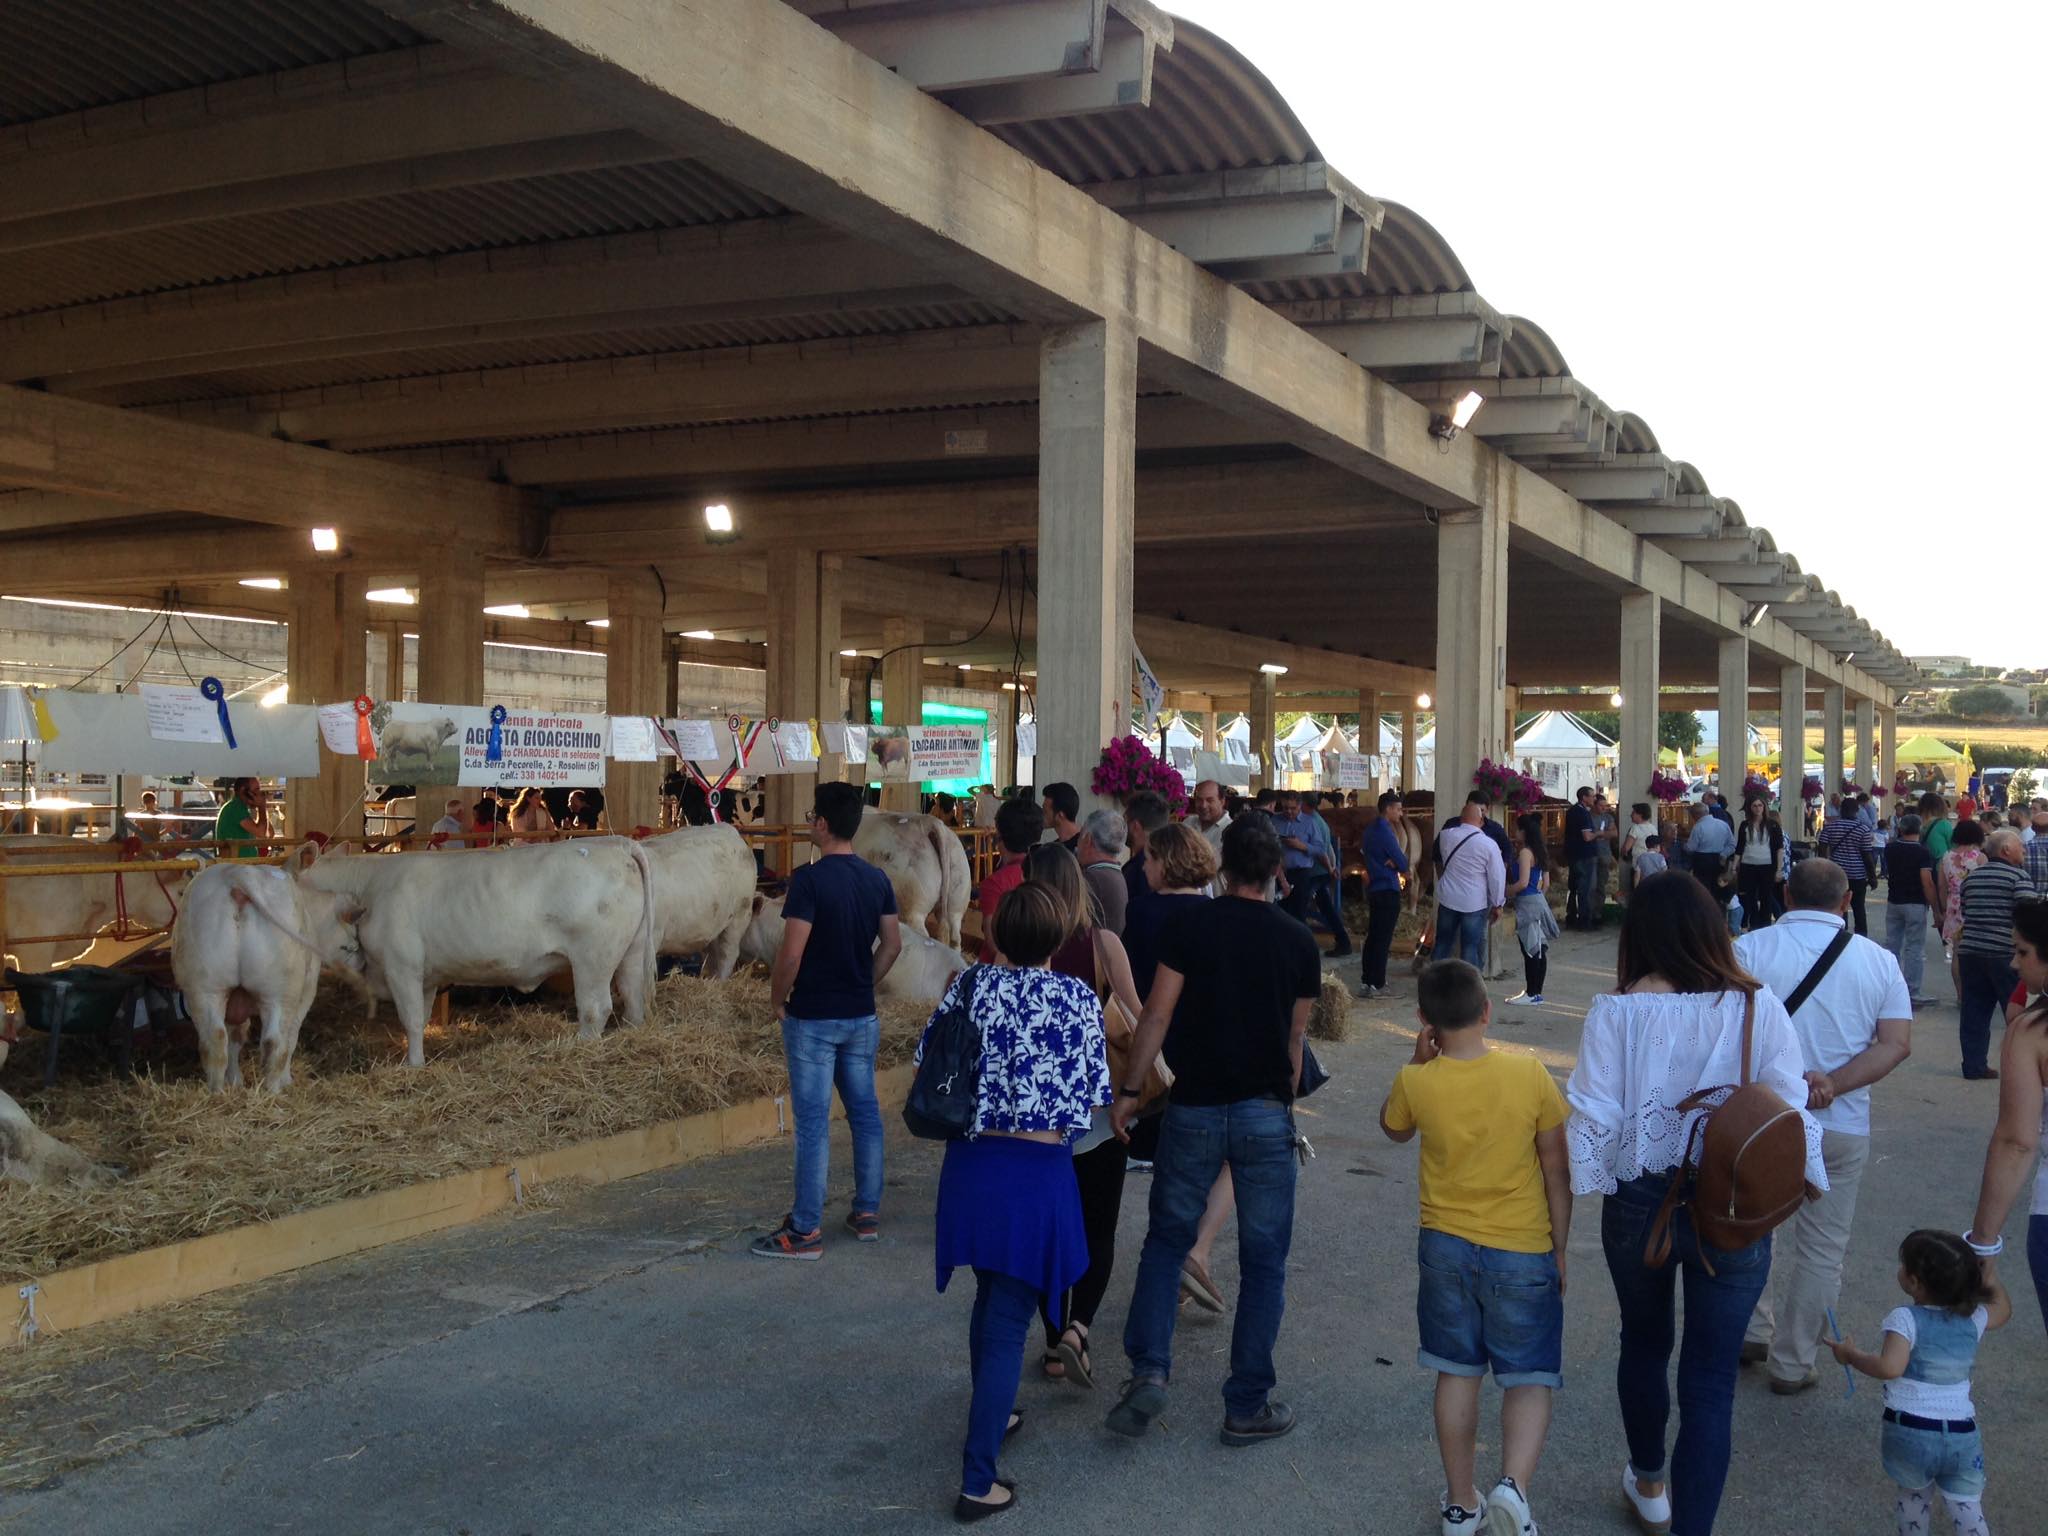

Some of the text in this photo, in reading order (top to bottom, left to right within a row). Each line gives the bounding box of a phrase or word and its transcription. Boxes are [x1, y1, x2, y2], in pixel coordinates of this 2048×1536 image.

[537, 717, 584, 729] agricola
[523, 729, 602, 749] GIOACCHINO
[513, 748, 560, 759] CHAROLAISE
[561, 751, 569, 759] in
[570, 750, 601, 760] selezione
[464, 758, 482, 768] C.da
[484, 759, 506, 769] Serra
[547, 760, 553, 770] 2
[558, 760, 587, 771] Rosolini
